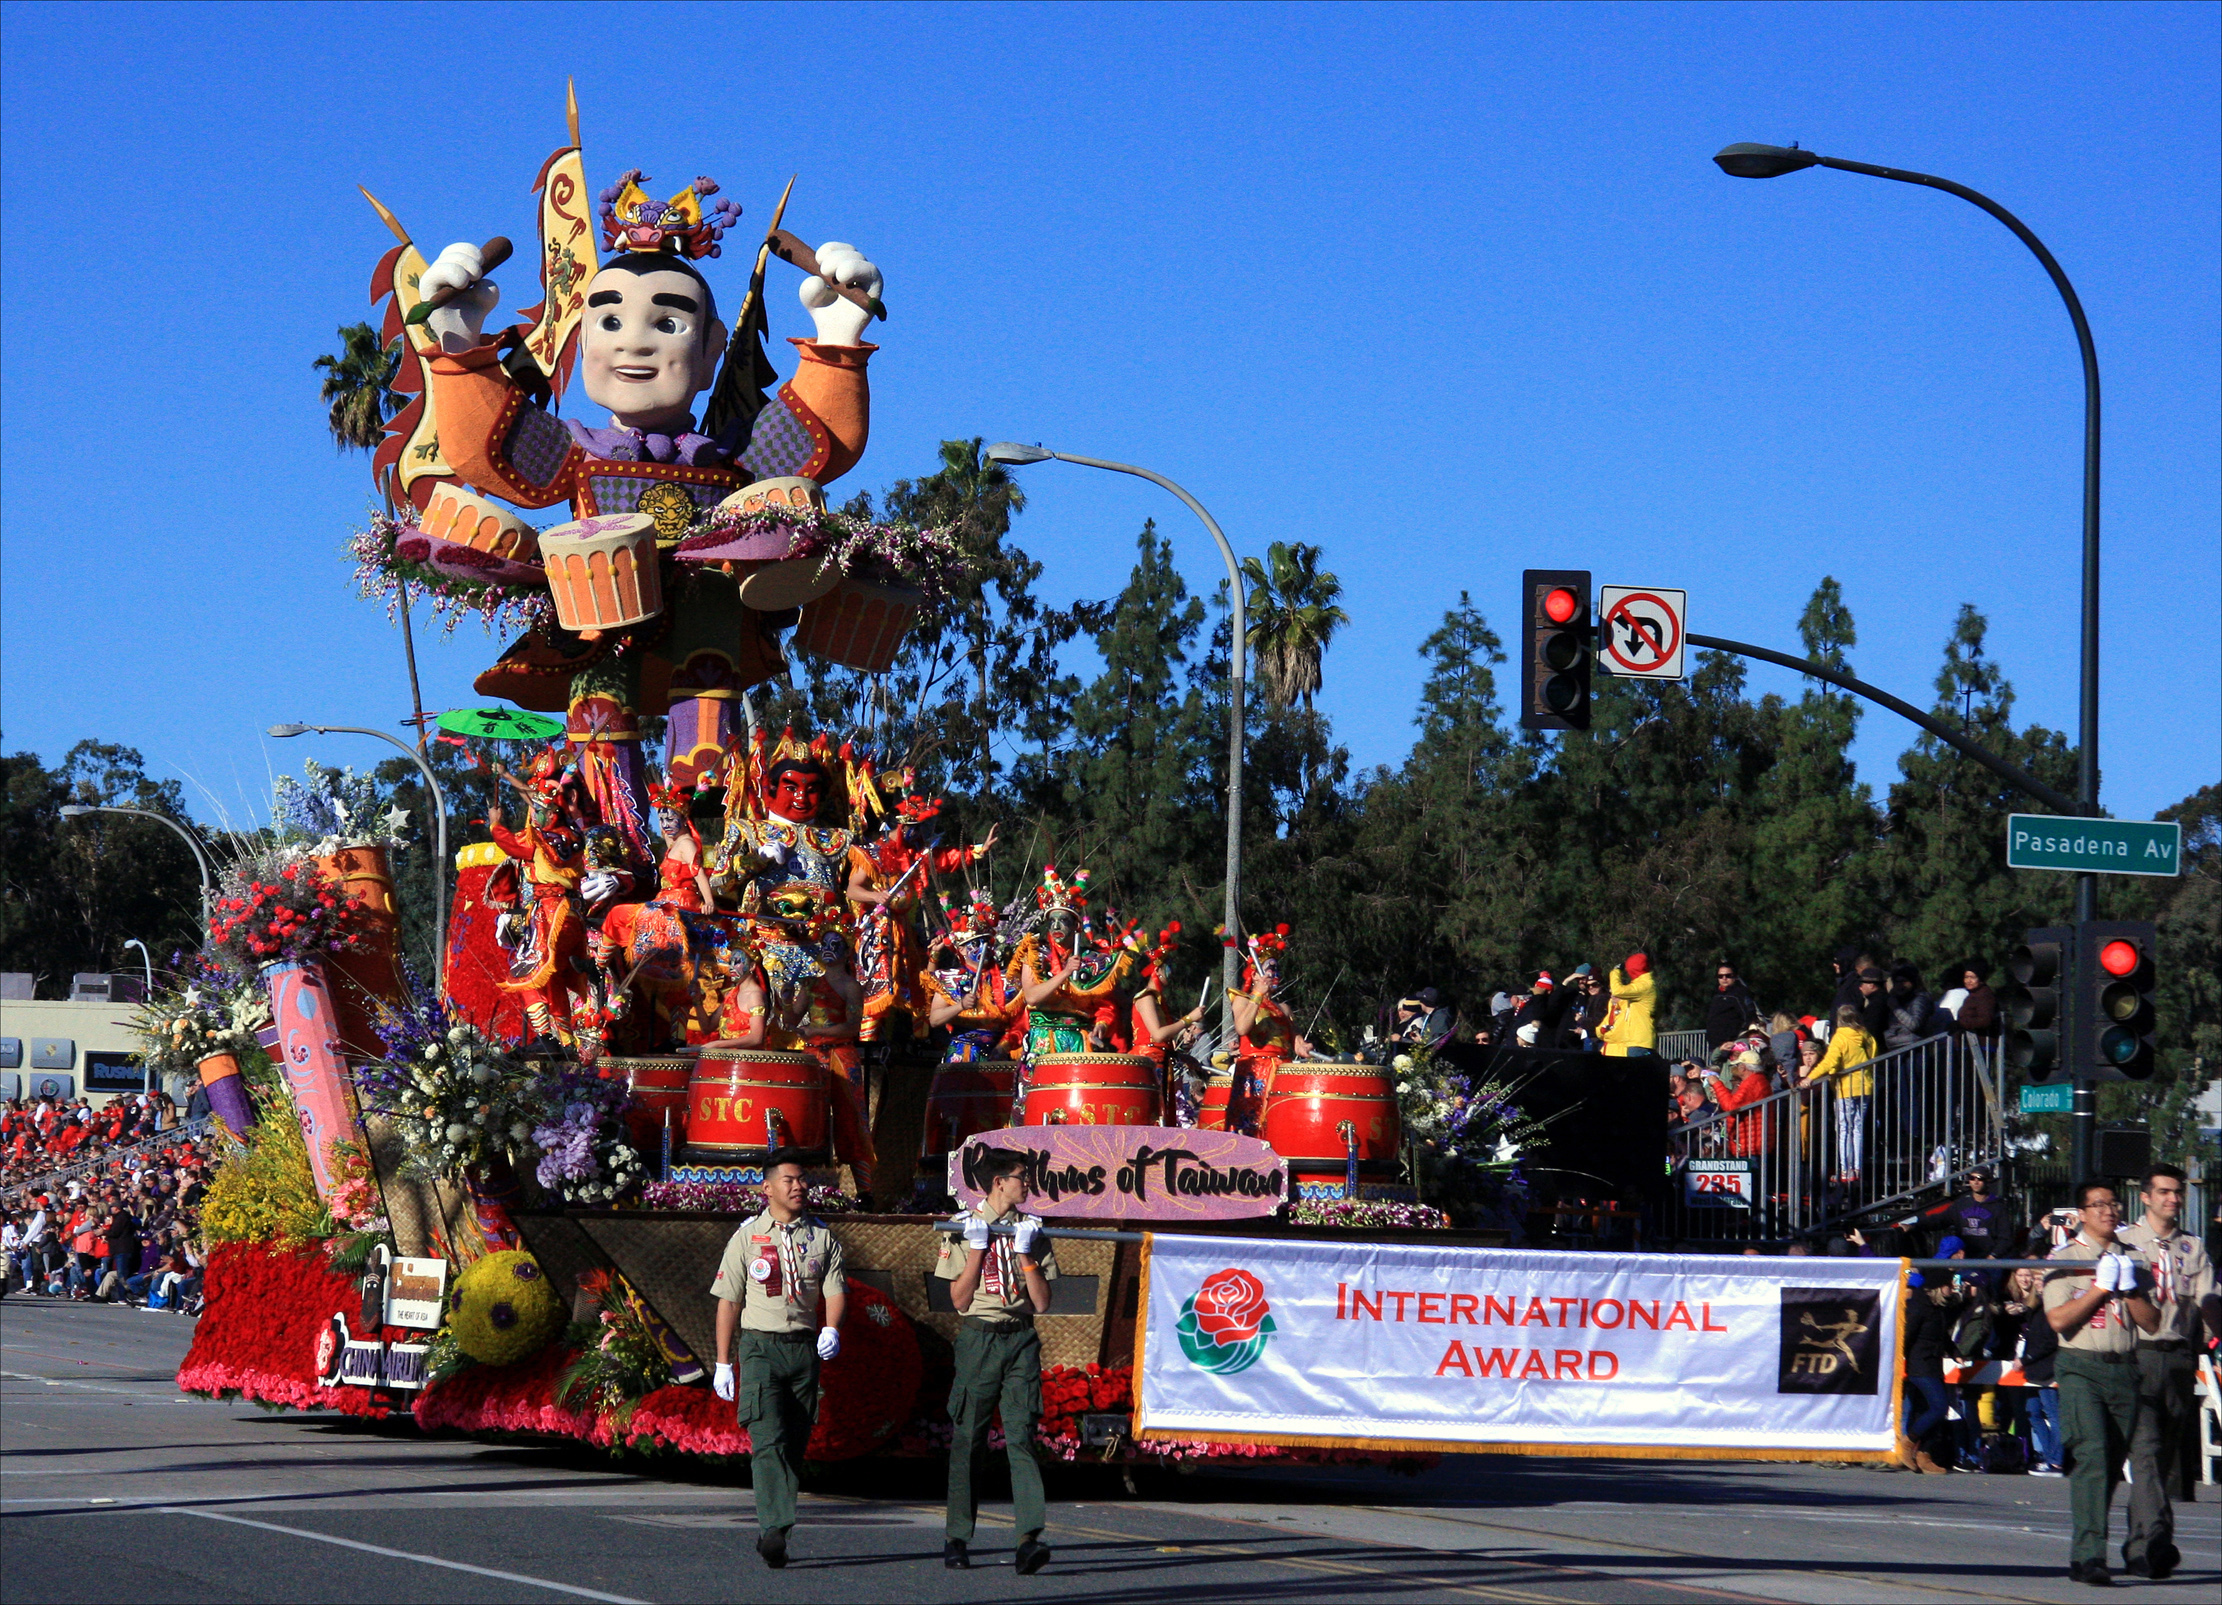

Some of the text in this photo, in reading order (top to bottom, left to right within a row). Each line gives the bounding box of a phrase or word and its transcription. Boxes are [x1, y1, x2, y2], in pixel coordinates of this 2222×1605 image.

[2015, 831, 2173, 859] Pasadena Av
[699, 1097, 753, 1123] STC
[2022, 1089, 2060, 1109] Colorado
[1079, 1102, 1141, 1126] STC
[962, 1141, 1284, 1203] Rthms of Taiwan
[1689, 1160, 1749, 1171] GRANDSTAND
[1696, 1174, 1741, 1195] 235
[1335, 1282, 1728, 1334] INTERNATIONAL
[340, 1346, 381, 1379] CHINA
[1434, 1339, 1620, 1381] AWARD
[1791, 1353, 1838, 1374] FTD
